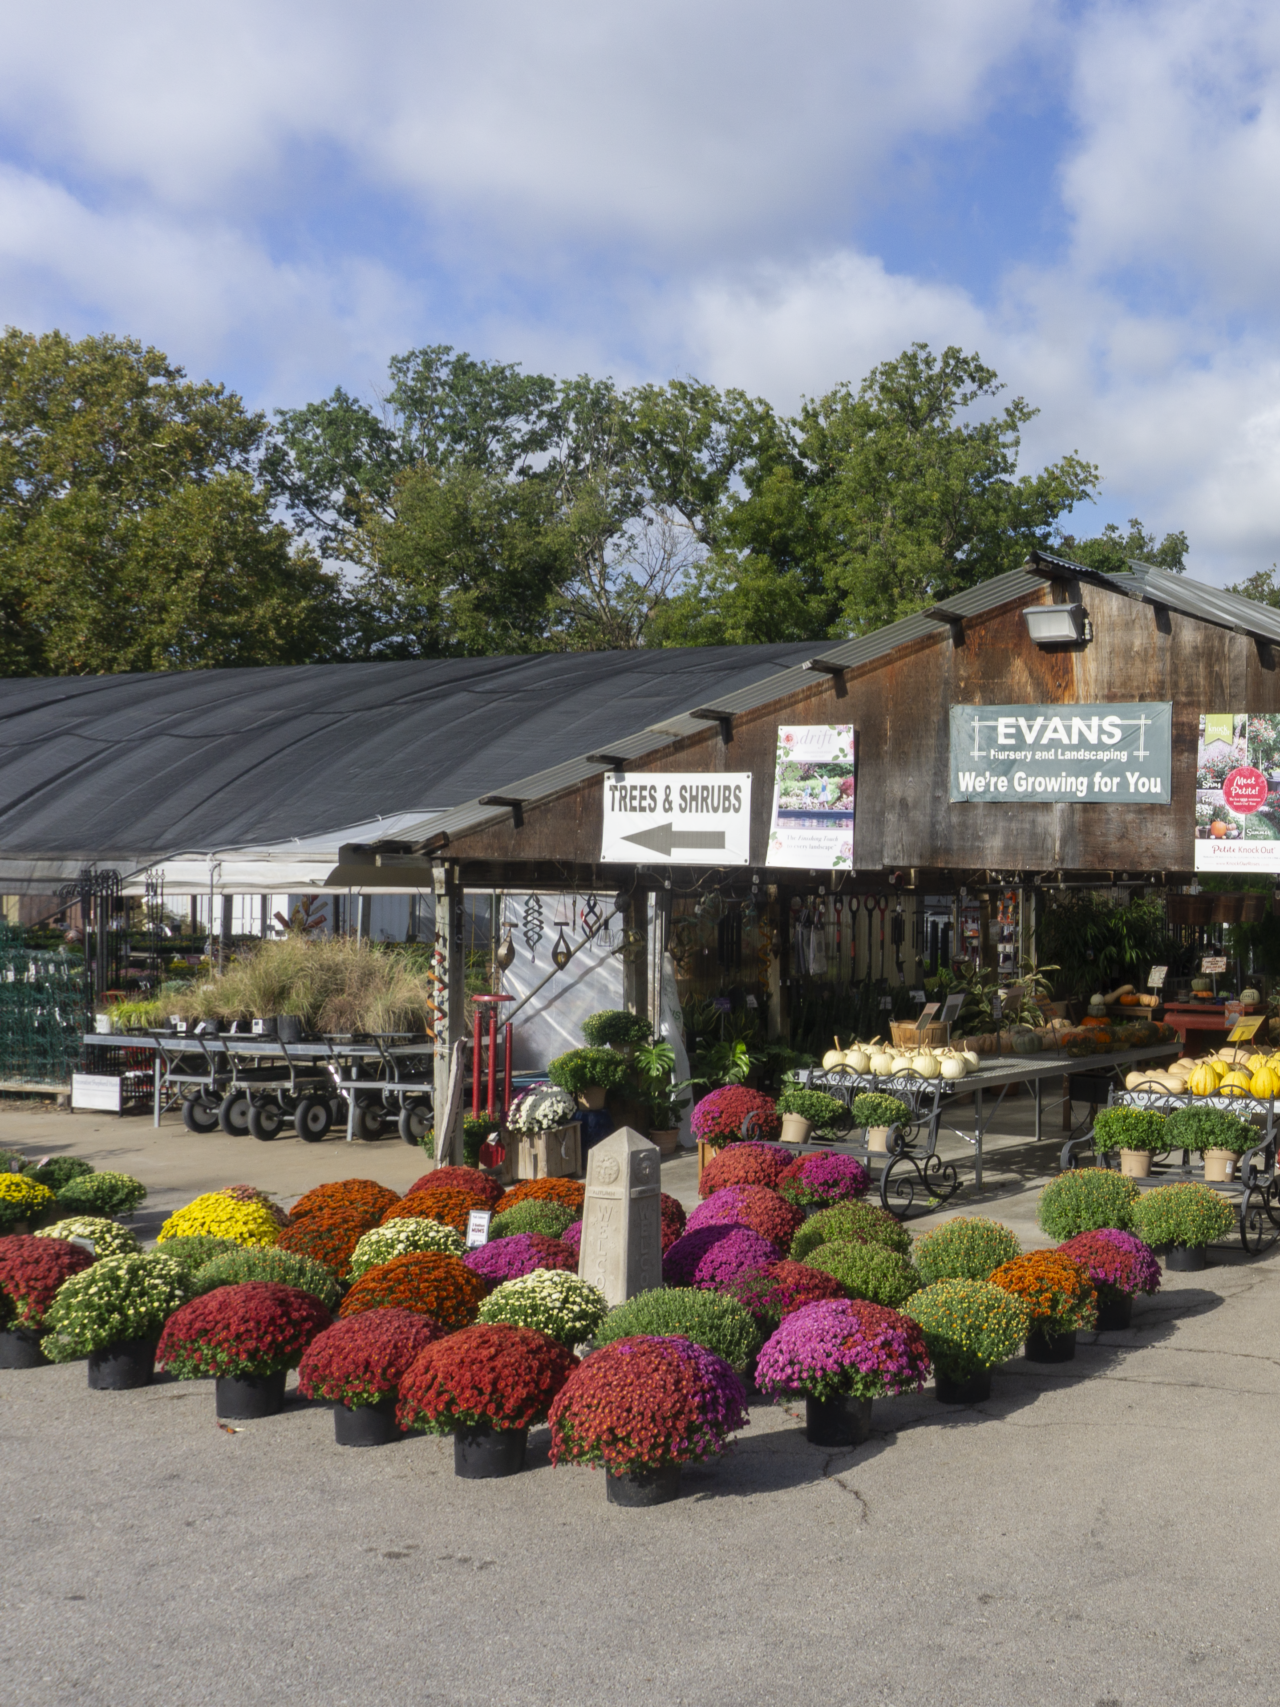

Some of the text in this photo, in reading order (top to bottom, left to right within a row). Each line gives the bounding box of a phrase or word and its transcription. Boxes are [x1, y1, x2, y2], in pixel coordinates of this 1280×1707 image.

[800, 729, 832, 749] drift
[998, 716, 1122, 744] EVANS
[990, 749, 1128, 762] Nursery and Landscaping
[958, 772, 1161, 797] We're Growing for You
[1234, 776, 1256, 786] Meet
[609, 784, 742, 813] TREES & SHRUBS
[1212, 845, 1235, 854] Petite
[1238, 846, 1259, 854] Knock
